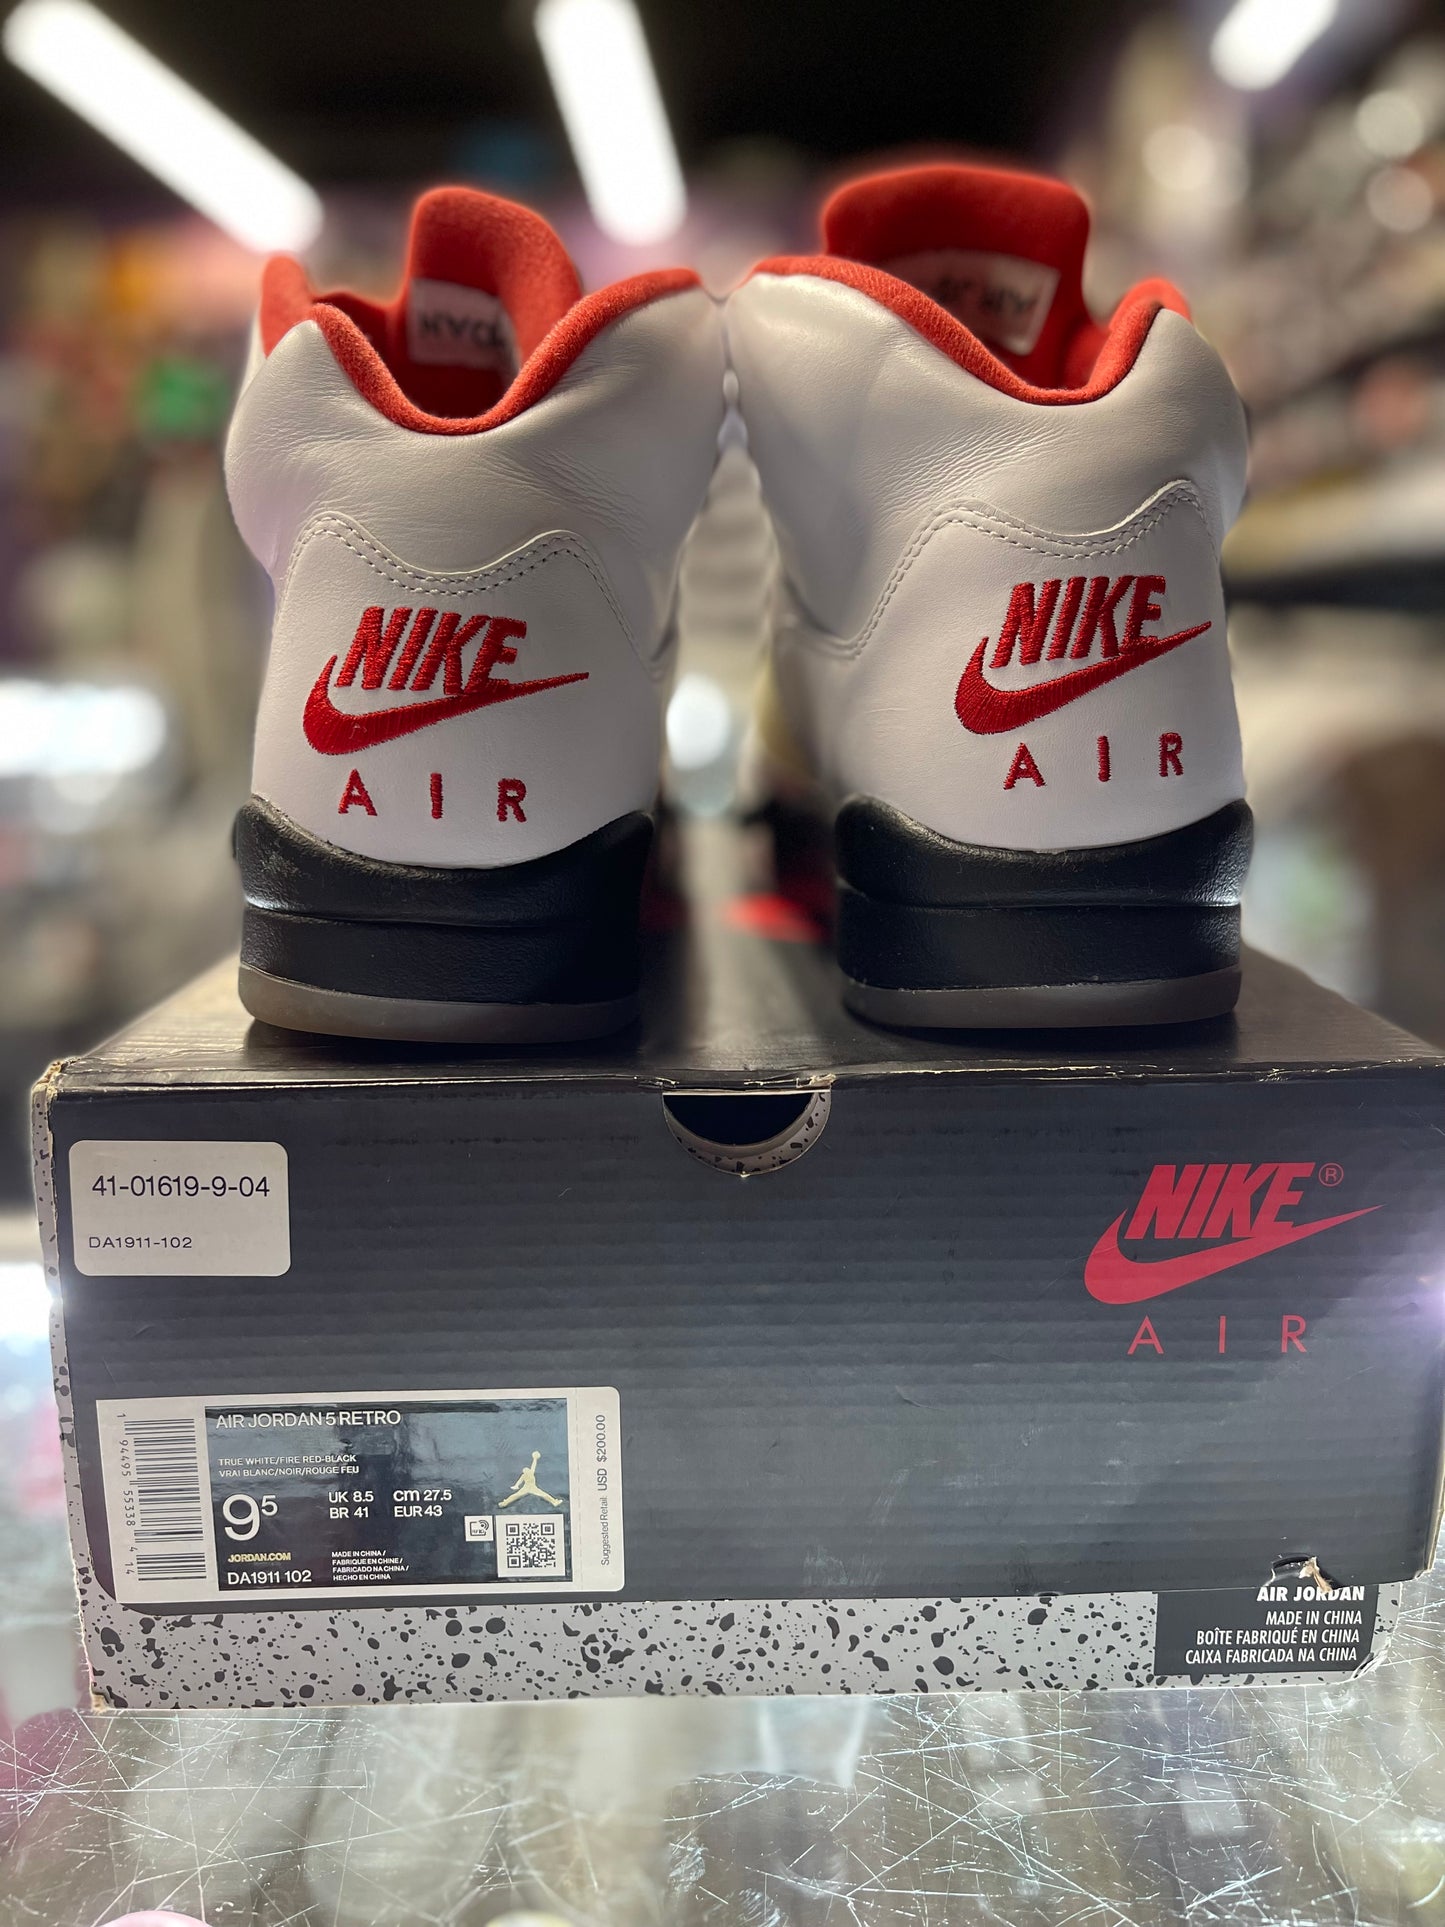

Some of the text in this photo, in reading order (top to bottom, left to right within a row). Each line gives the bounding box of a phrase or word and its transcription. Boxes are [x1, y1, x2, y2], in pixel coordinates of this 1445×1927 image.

[989, 575, 1166, 669] NIKE
[334, 606, 527, 695] NIKE
[1003, 732, 1184, 790] AIR
[338, 768, 527, 823] AIR
[92, 1175, 270, 1198] 41-01619-9-04
[88, 1236, 193, 1249] DA1911-102
[1127, 1314, 1308, 1355] AIR
[216, 1409, 402, 1429] AIR JORDAN 5 RETRO
[595, 1414, 608, 1463] $200.00
[118, 1439, 132, 1478] 94495
[218, 1454, 357, 1467] TRUE WHITE/FIRE RED-BLACK
[219, 1465, 360, 1478] VRAI BLANC/NOIR/ROUGE FEU
[597, 1468, 608, 1491] USD
[328, 1490, 375, 1503] UK 8.5
[393, 1489, 453, 1502] cm 27.5
[123, 1490, 137, 1528] 55338
[329, 1506, 369, 1519] BR 41
[394, 1505, 443, 1518] EUR 43
[600, 1523, 611, 1566] Suggested
[227, 1552, 291, 1564] JORDAN.COM
[227, 1569, 313, 1585] DA1911 102
[1256, 1586, 1288, 1602] AIR
[1265, 1610, 1363, 1625] MADE IN CHINA
[1196, 1627, 1360, 1645] BOÎTE FABRIQUÉ EN CHINA
[1185, 1647, 1357, 1664] CAIXA FABRICADA NA CHINA
